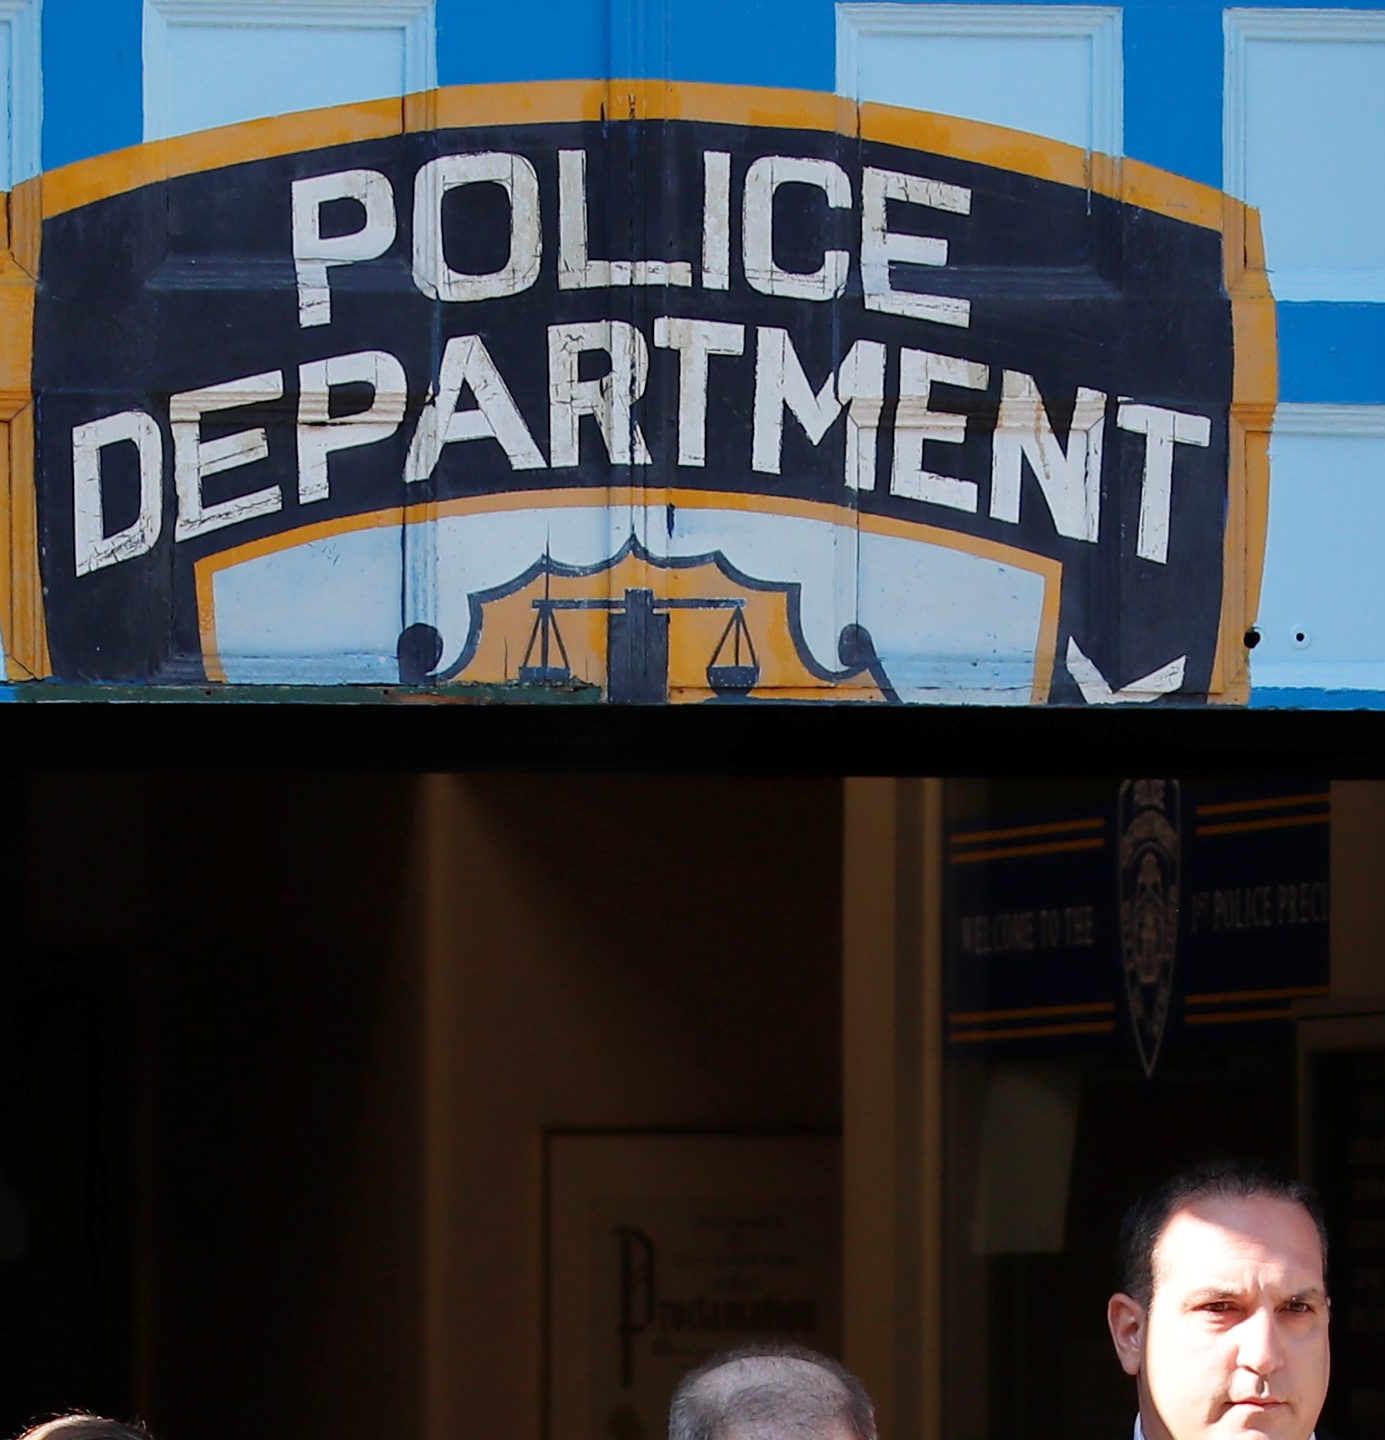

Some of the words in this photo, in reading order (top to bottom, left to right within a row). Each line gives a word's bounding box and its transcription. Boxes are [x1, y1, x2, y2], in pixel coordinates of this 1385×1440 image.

[291, 148, 972, 329] POLICE
[71, 315, 1212, 578] DEPARTMENT
[961, 911, 1035, 954] WELCOME
[1040, 909, 1060, 948] TO
[1064, 905, 1095, 946] THE
[1213, 886, 1272, 930] POLICE
